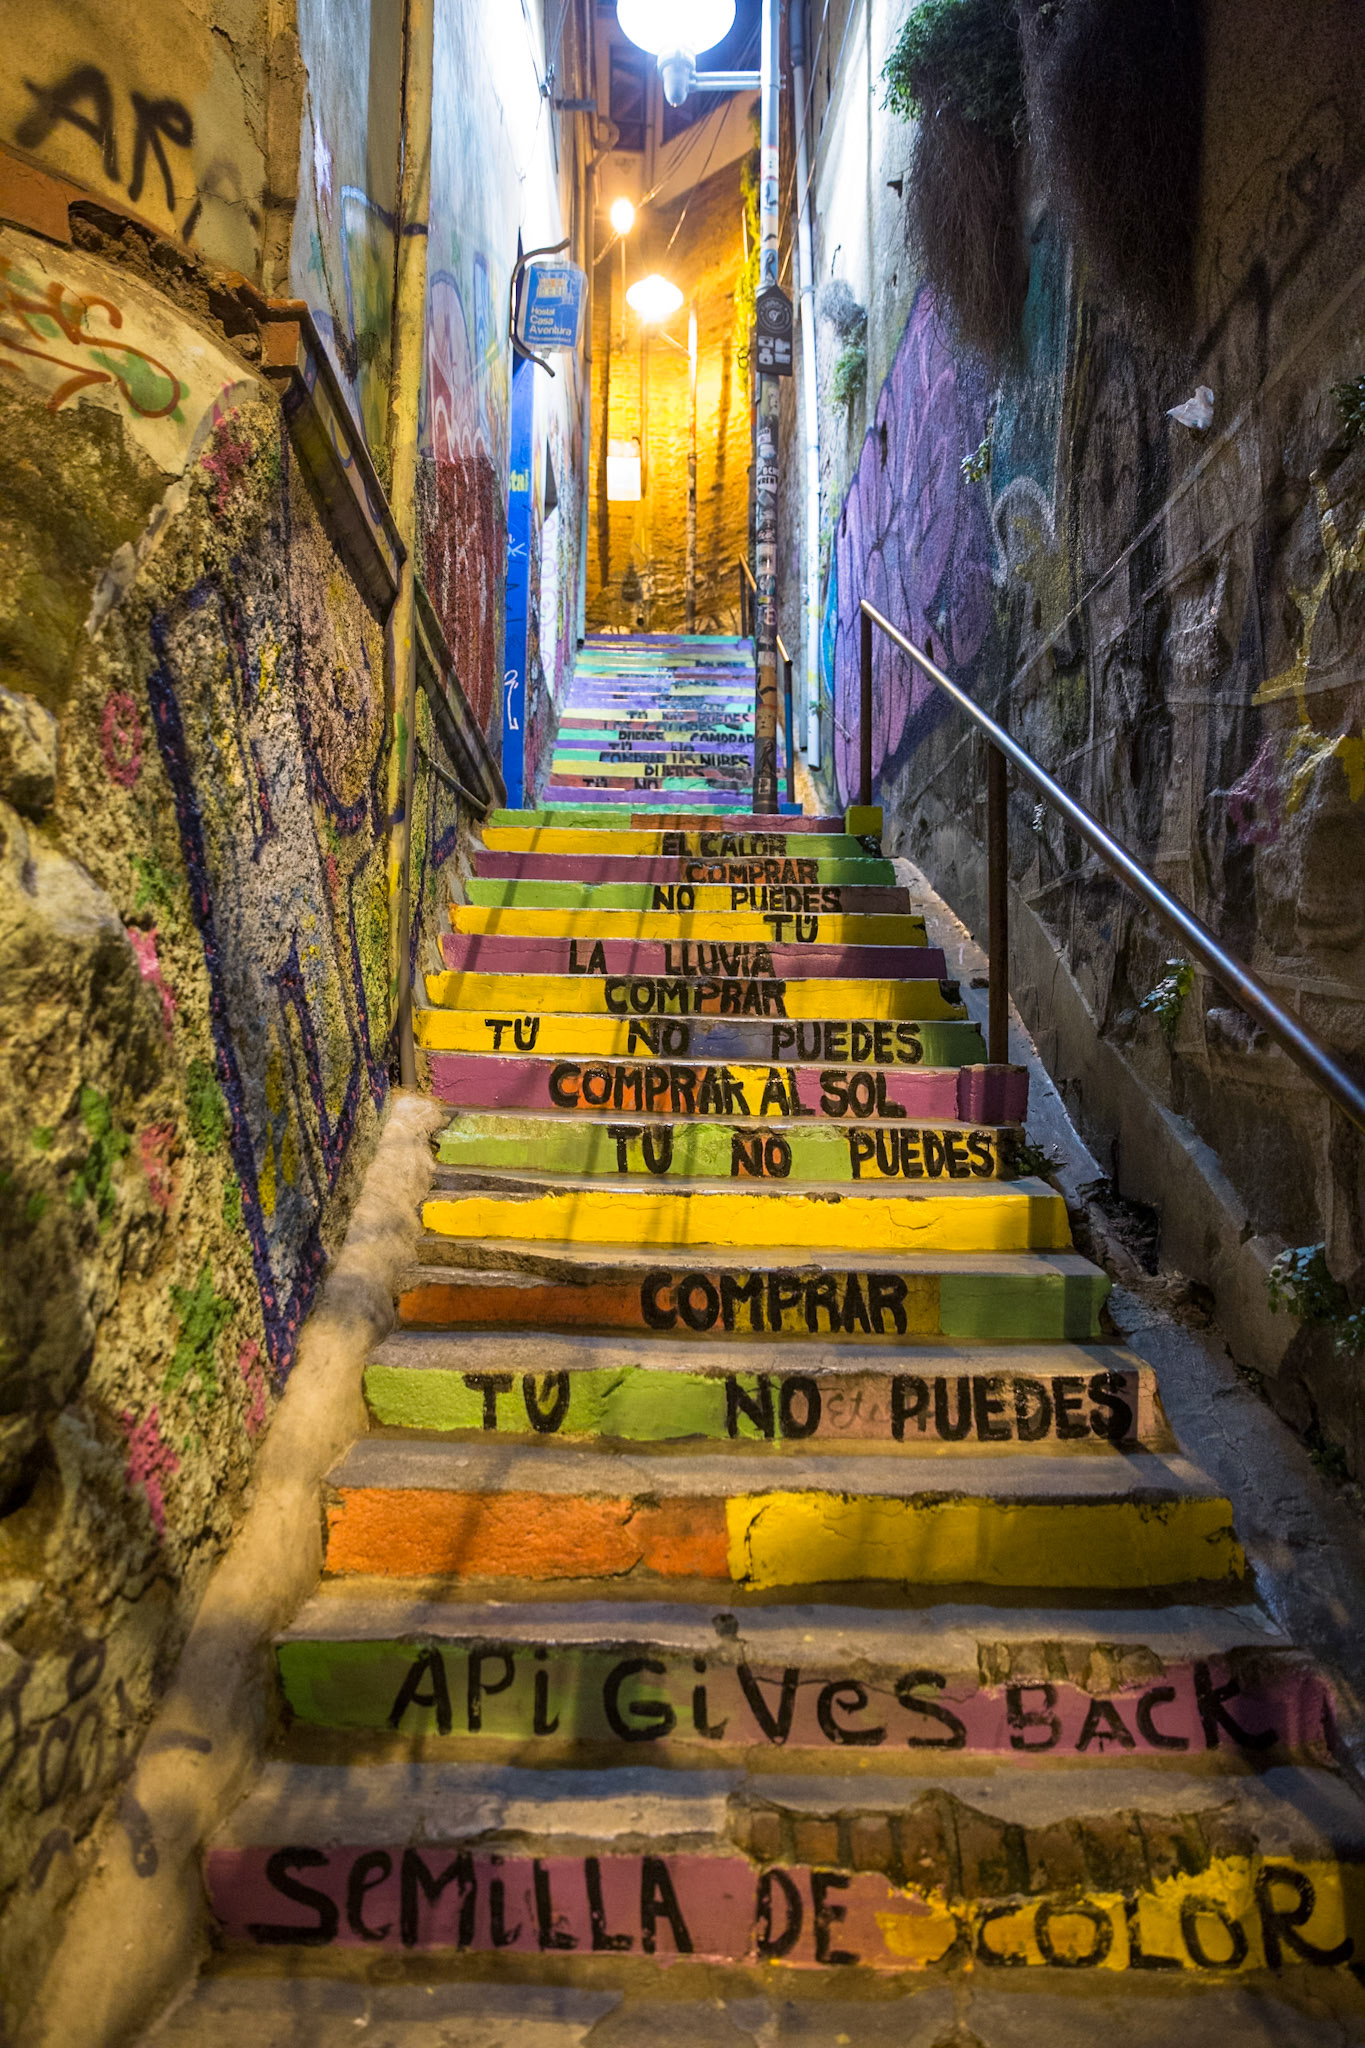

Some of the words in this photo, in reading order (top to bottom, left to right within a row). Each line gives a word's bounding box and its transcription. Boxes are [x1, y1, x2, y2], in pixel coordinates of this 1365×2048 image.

[529, 325, 572, 336] Aventura
[530, 315, 554, 325] Casa
[531, 306, 555, 315] Hostal
[662, 832, 692, 856] EL
[700, 832, 787, 857] CALOR
[685, 858, 819, 885] COMPRAR
[652, 885, 695, 910] NO
[731, 884, 842, 913] PUEDES
[569, 938, 606, 974] LA
[665, 938, 774, 978] LLUVIA
[604, 976, 786, 1018] COMPRAR
[628, 1019, 690, 1056] NO
[772, 1021, 923, 1063] PUEDES
[550, 1062, 750, 1116] COMPRAR
[760, 1067, 815, 1117] AL
[820, 1070, 908, 1119] SOL
[731, 1132, 792, 1178] NO
[848, 1126, 996, 1179] PUEDES
[640, 1270, 908, 1335] COMPRAR
[724, 1373, 822, 1440] NO
[890, 1371, 1134, 1444] PUEDES
[1004, 1660, 1280, 1754] BACK
[758, 1868, 866, 1966] DE
[974, 1862, 1357, 1978] COLOR
